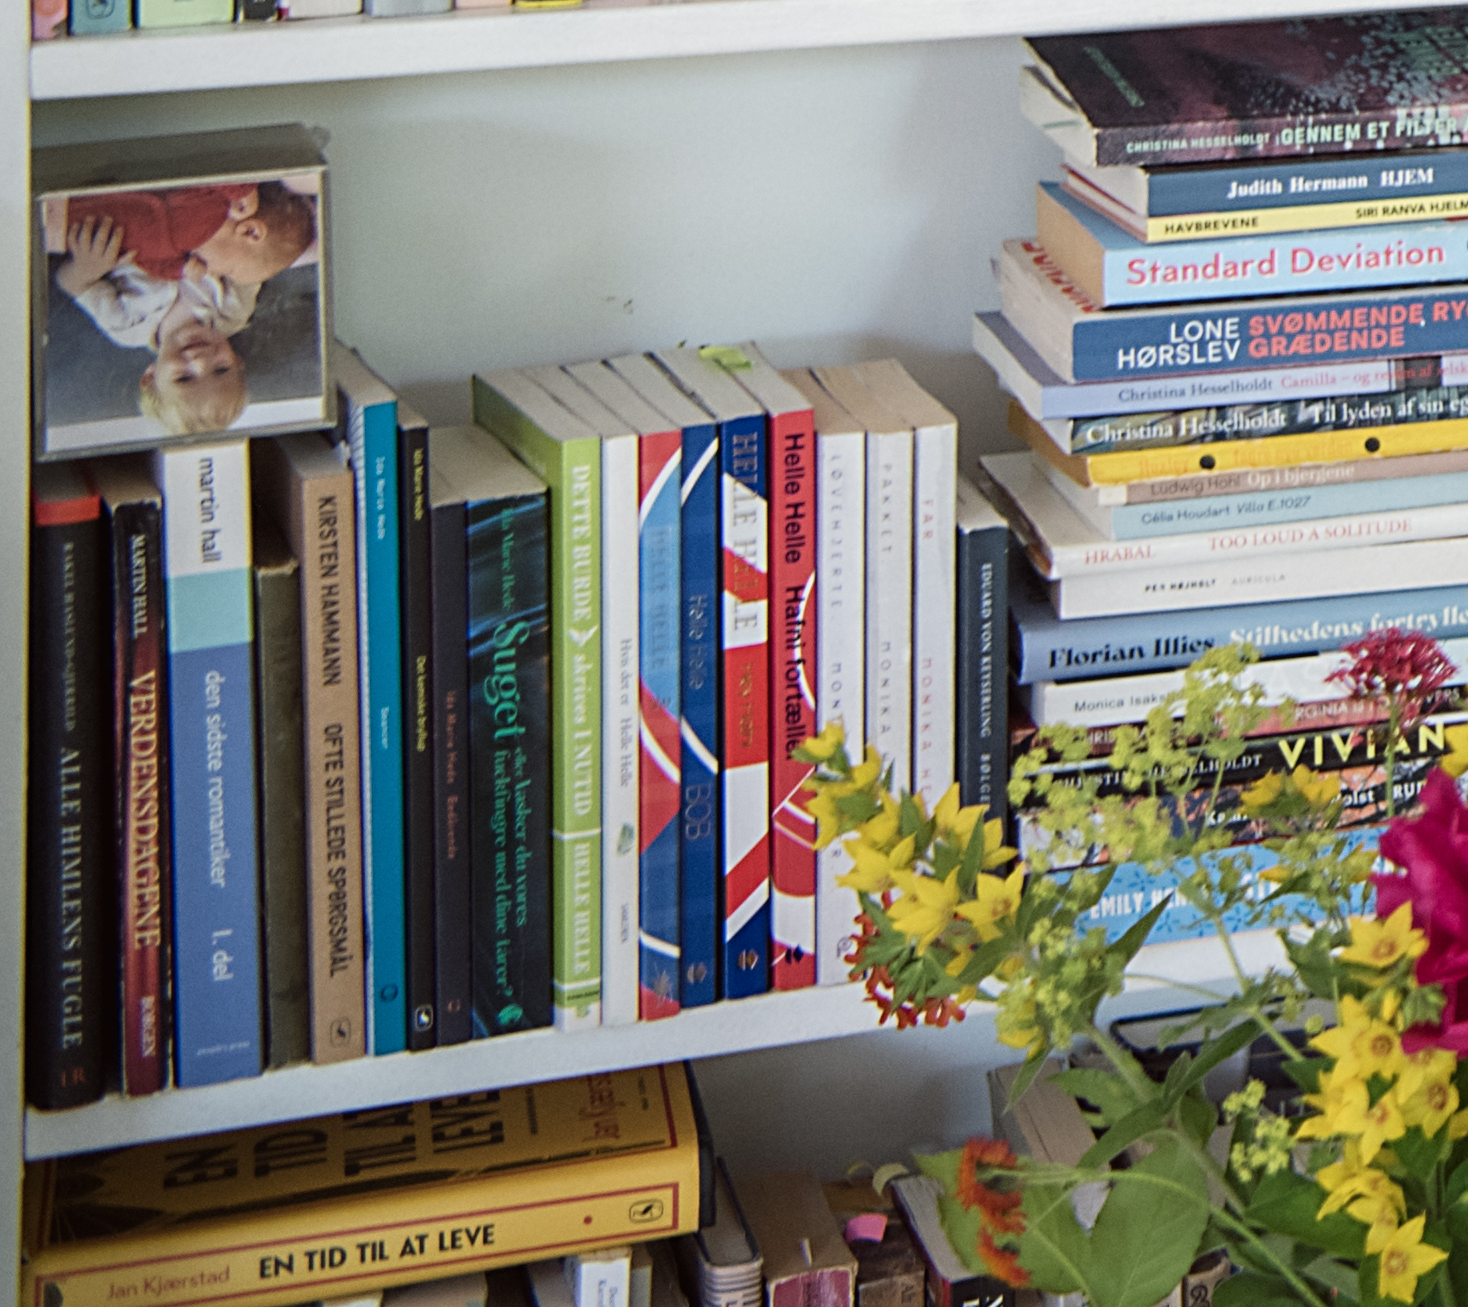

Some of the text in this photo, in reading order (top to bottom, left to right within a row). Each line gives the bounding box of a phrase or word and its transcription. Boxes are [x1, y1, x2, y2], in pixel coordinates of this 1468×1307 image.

[1126, 242, 1444, 287] Standard Deviation
[1169, 318, 1240, 344] LONE
[1248, 327, 1405, 357] GRÆDENDE
[1116, 342, 1241, 370] HØRSLEV
[199, 456, 222, 563] martin hall
[1278, 723, 1447, 768] VIVIAN
[258, 1223, 496, 1280] EN TID TIL AT LEVE
